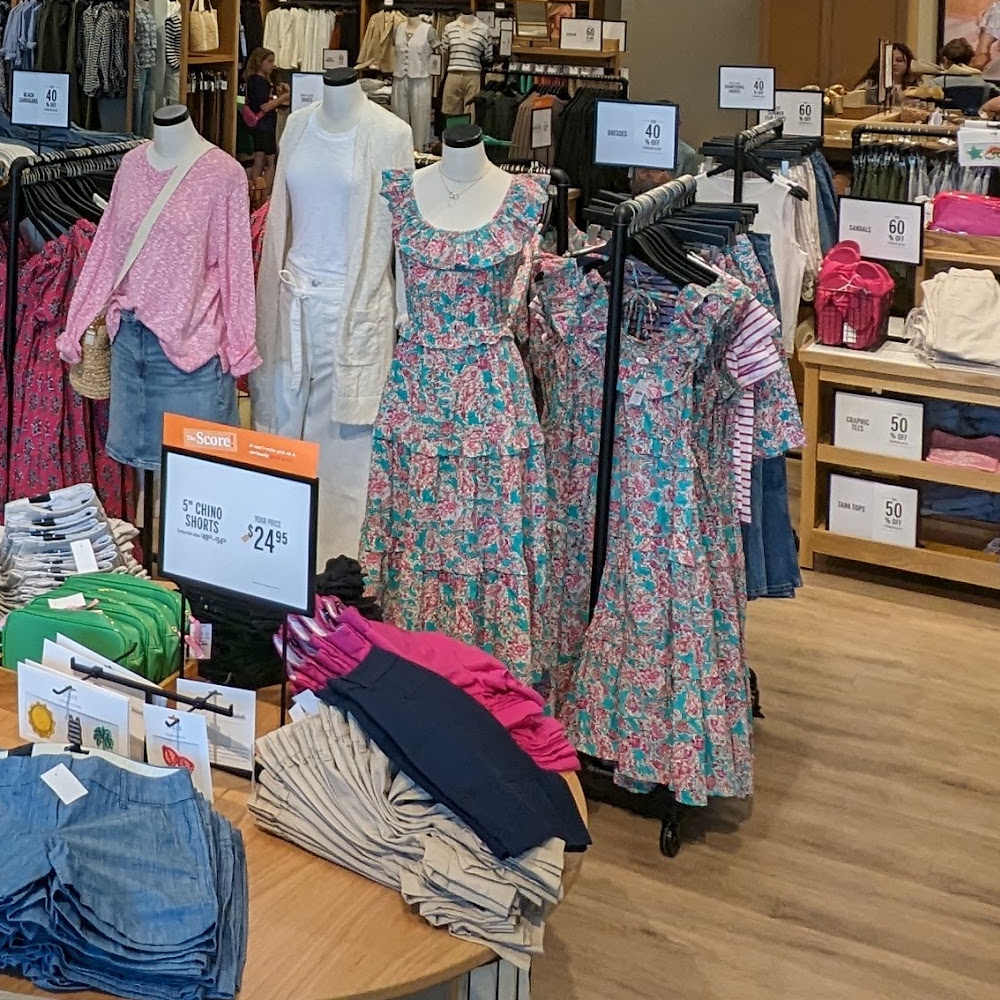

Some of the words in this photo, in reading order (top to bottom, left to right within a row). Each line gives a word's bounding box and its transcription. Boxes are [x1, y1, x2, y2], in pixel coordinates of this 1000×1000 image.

[754, 80, 764, 90] 40
[46, 89, 57, 102] 40
[799, 105, 811, 116] 60
[645, 124, 660, 138] 40
[849, 225, 871, 233] SANDALS
[889, 219, 905, 234] 60
[846, 416, 870, 426] GRAPHIC
[891, 416, 908, 433] 50
[852, 424, 864, 432] TEES
[183, 499, 193, 511] 5"
[196, 502, 222, 520] CHINO
[838, 501, 851, 509] TANK
[853, 503, 865, 512] TOPS
[885, 501, 902, 518] 50
[185, 514, 219, 534] SHORTS
[255, 515, 267, 524] YOUR
[267, 518, 281, 528] PRICE
[892, 518, 902, 526] OFF
